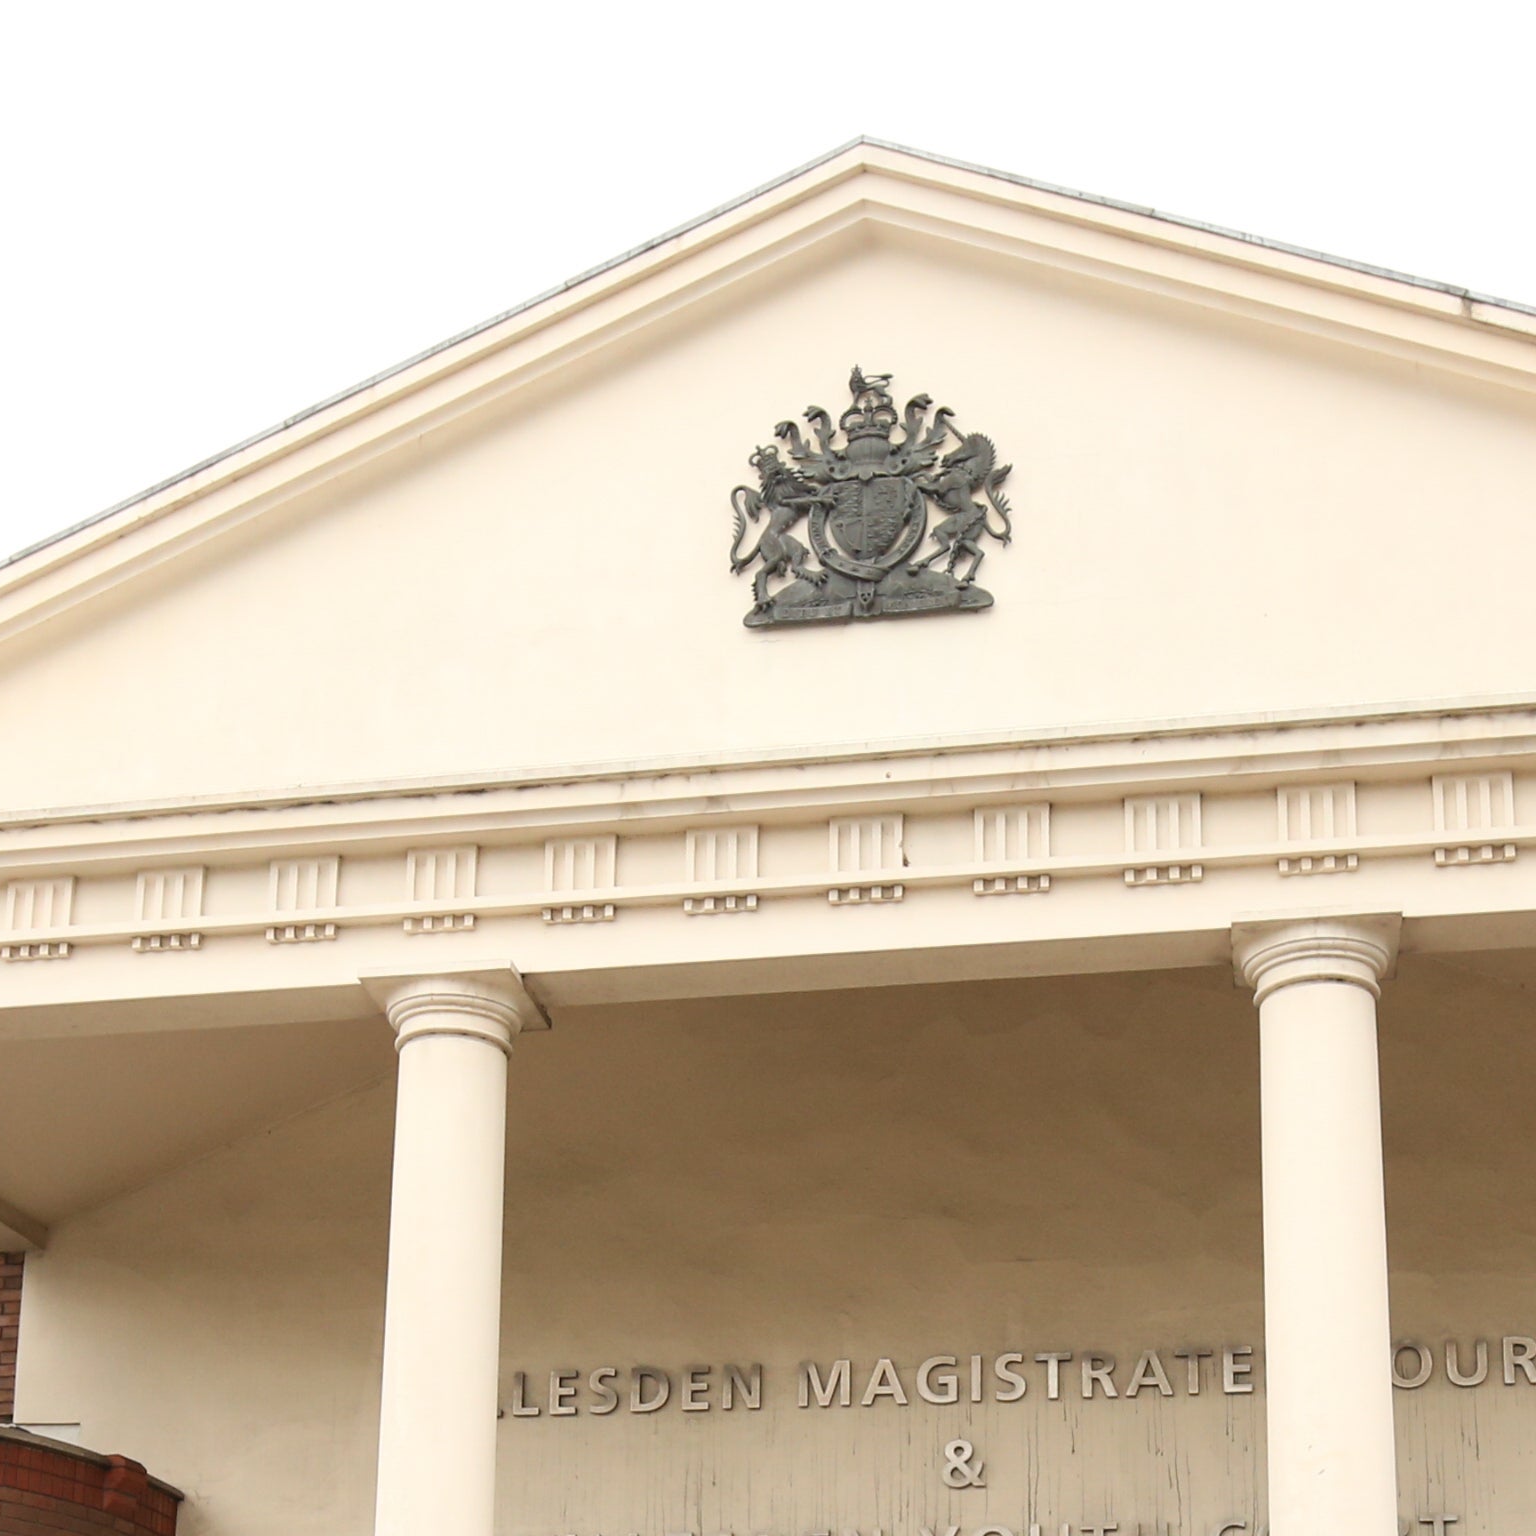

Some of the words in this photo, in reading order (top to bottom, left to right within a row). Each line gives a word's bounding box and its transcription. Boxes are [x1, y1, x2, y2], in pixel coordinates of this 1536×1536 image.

[498, 1363, 763, 1418] LESDEN
[797, 1345, 1255, 1409] MAGISTRATE
[941, 1438, 987, 1488] &
